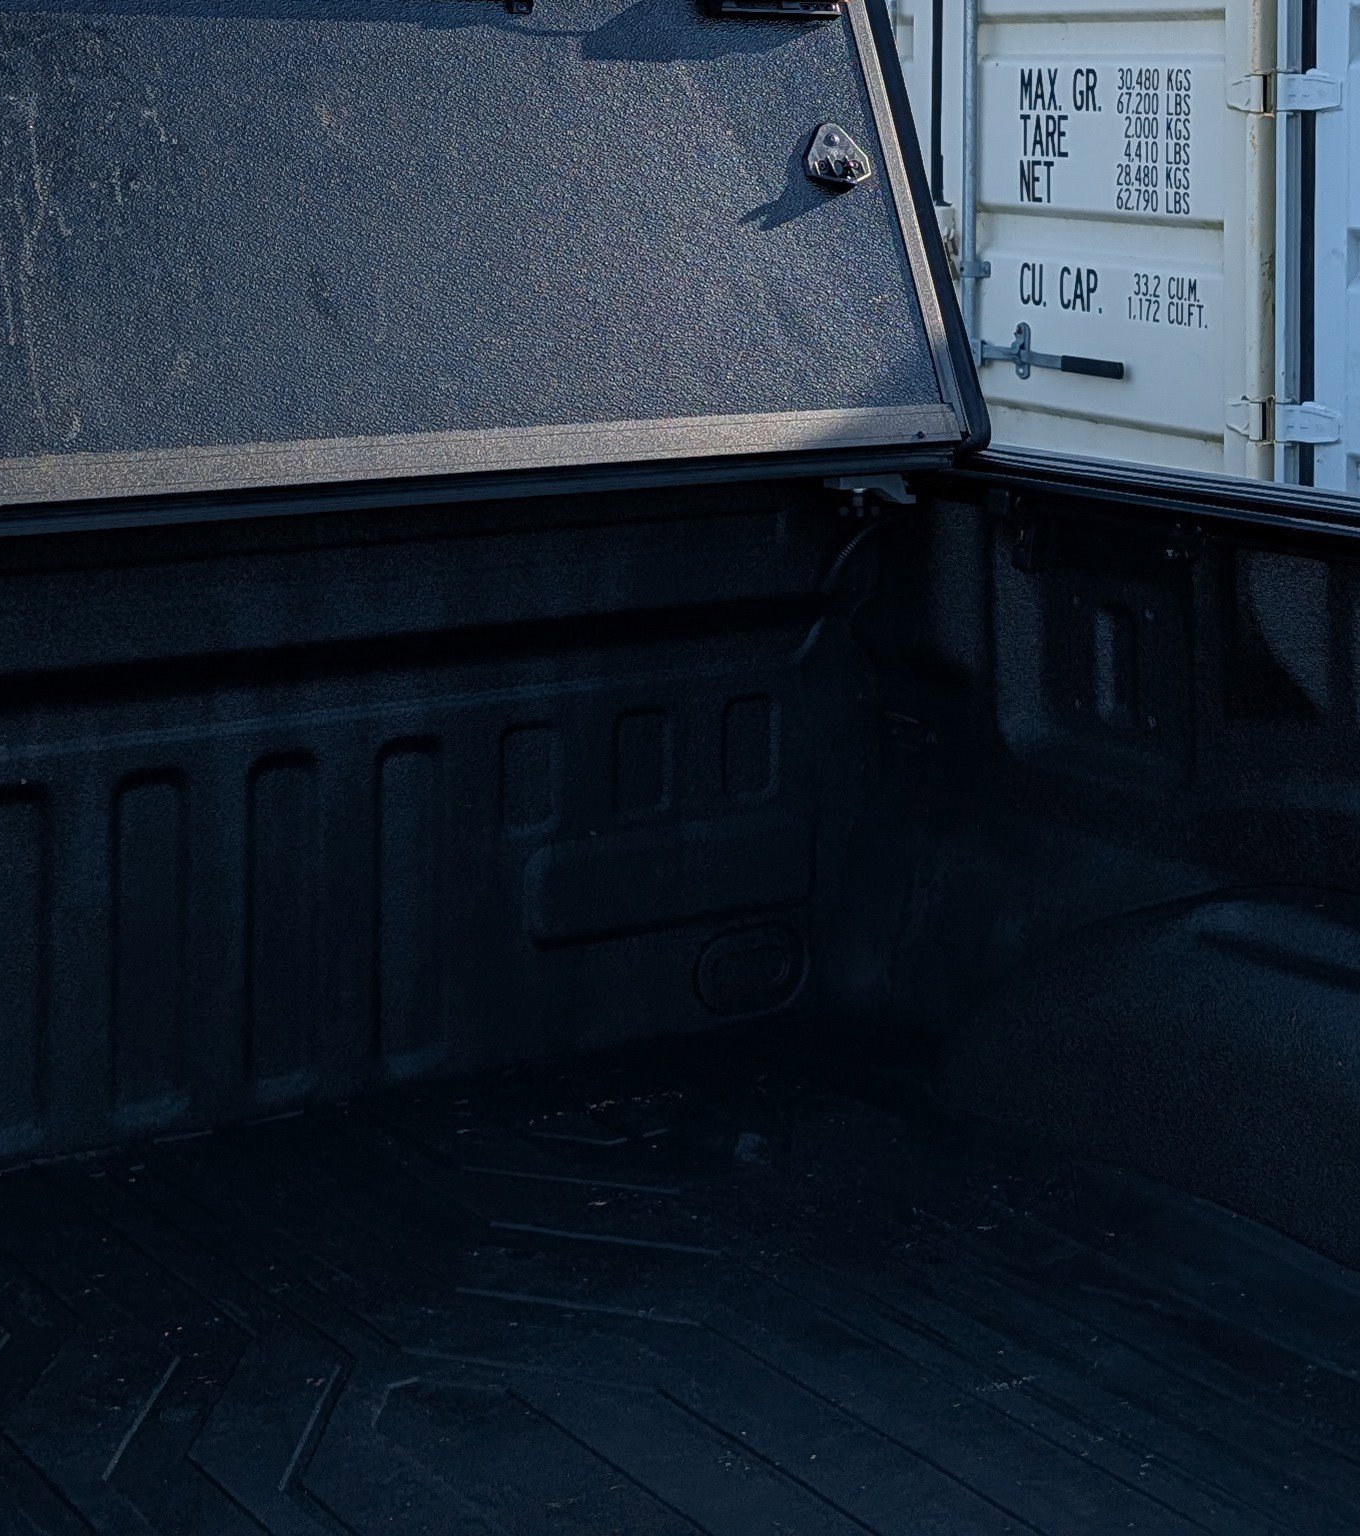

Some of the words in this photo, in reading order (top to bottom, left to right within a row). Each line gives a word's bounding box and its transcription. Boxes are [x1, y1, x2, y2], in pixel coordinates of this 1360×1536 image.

[1020, 68, 1062, 111] MAX.
[1073, 68, 1102, 112] GR.
[1167, 68, 1192, 92] KGS
[1166, 93, 1191, 116] LBS
[1020, 114, 1069, 157] TARE
[1166, 117, 1191, 141] KGS
[1165, 142, 1191, 166] LBS
[1020, 160, 1055, 203] NET
[1166, 166, 1190, 190] KGS
[1166, 191, 1190, 215] LBS
[1020, 262, 1047, 307] CU.
[1059, 266, 1103, 314] CAP.
[1133, 272, 1161, 299] 33.2
[1168, 276, 1200, 303] CU.M.
[1167, 301, 1208, 329] CU.FT.
